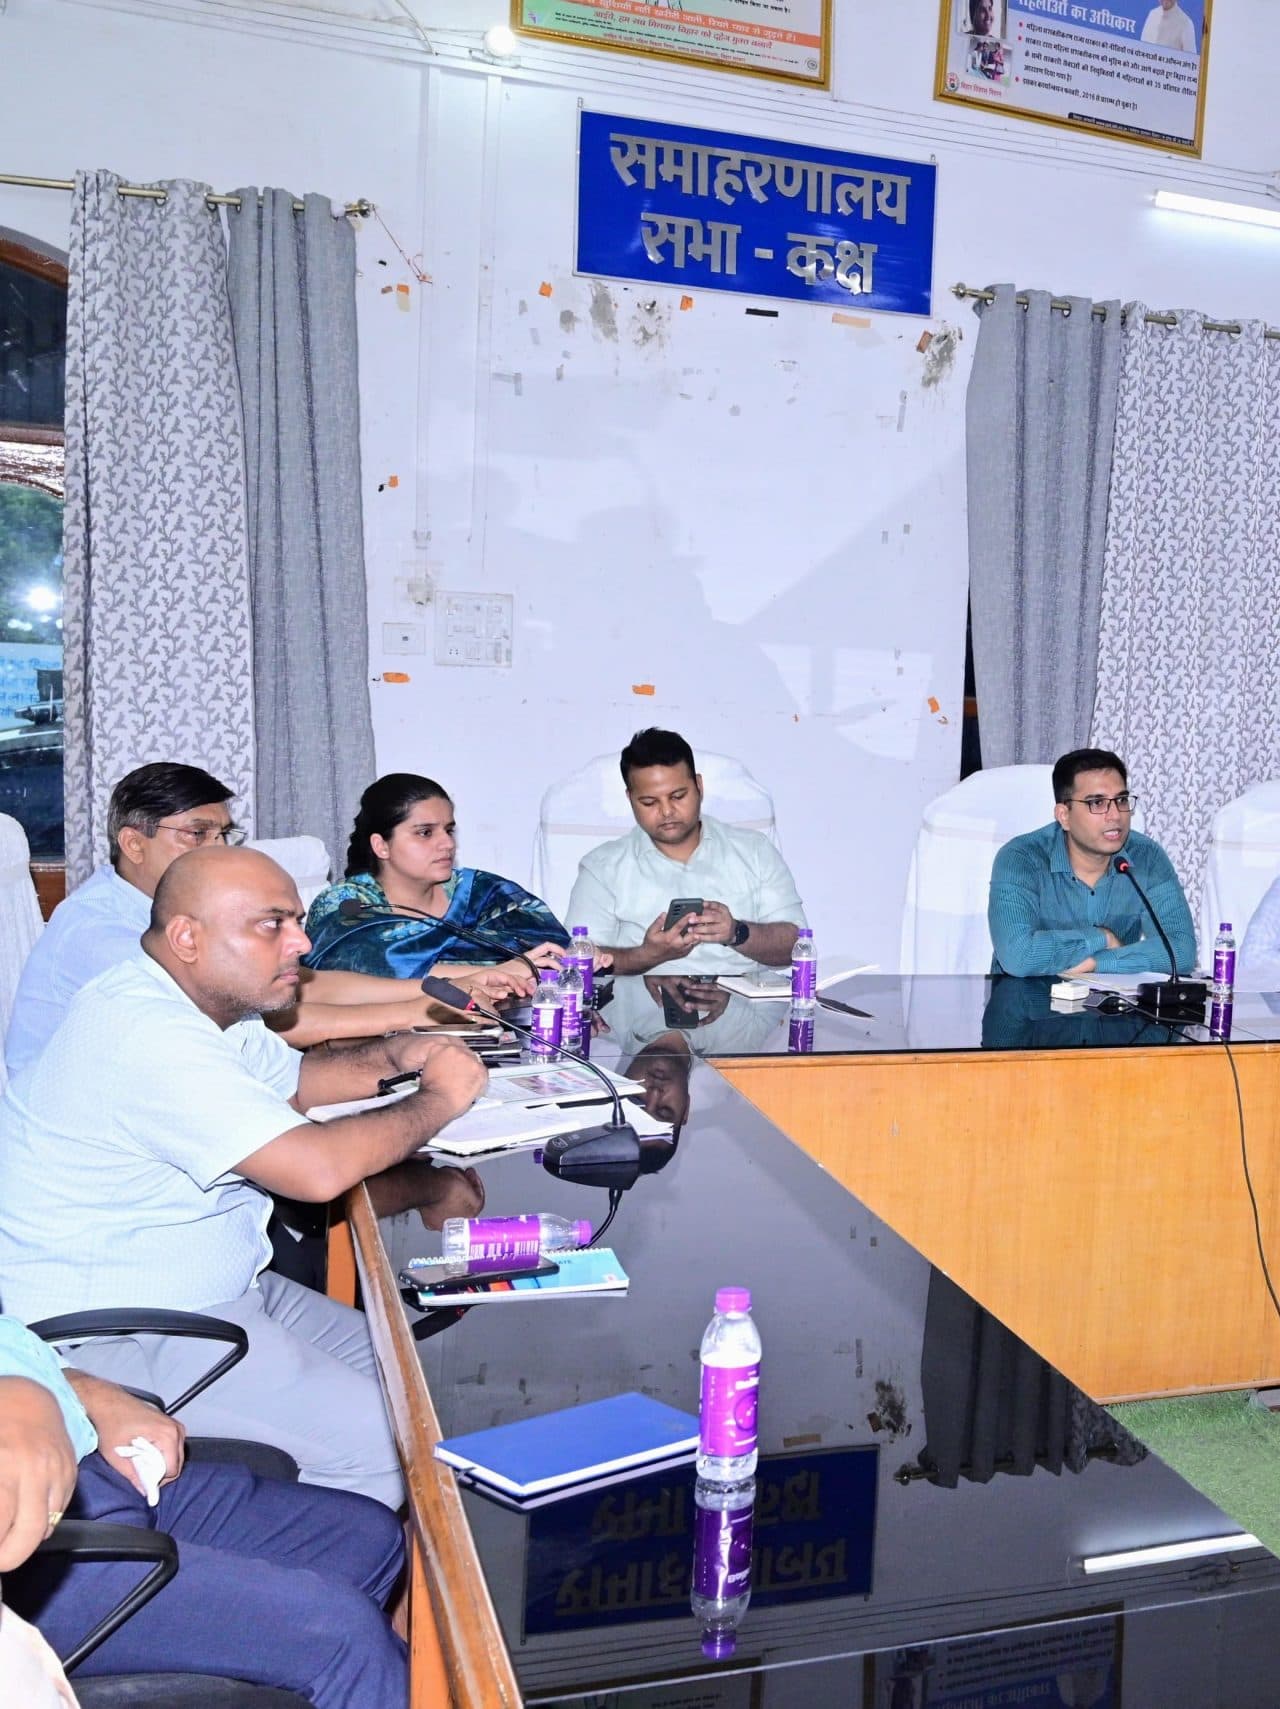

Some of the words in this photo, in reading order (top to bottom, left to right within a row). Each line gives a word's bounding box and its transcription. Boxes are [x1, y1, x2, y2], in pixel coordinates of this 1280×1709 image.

[1071, 5, 1088, 21] का
[1089, 9, 1137, 33] अधिकार
[1082, 92, 1096, 101] 2016
[609, 132, 912, 225] समाहरणालय
[640, 211, 742, 275] सभा
[786, 231, 878, 296] कक्ष
